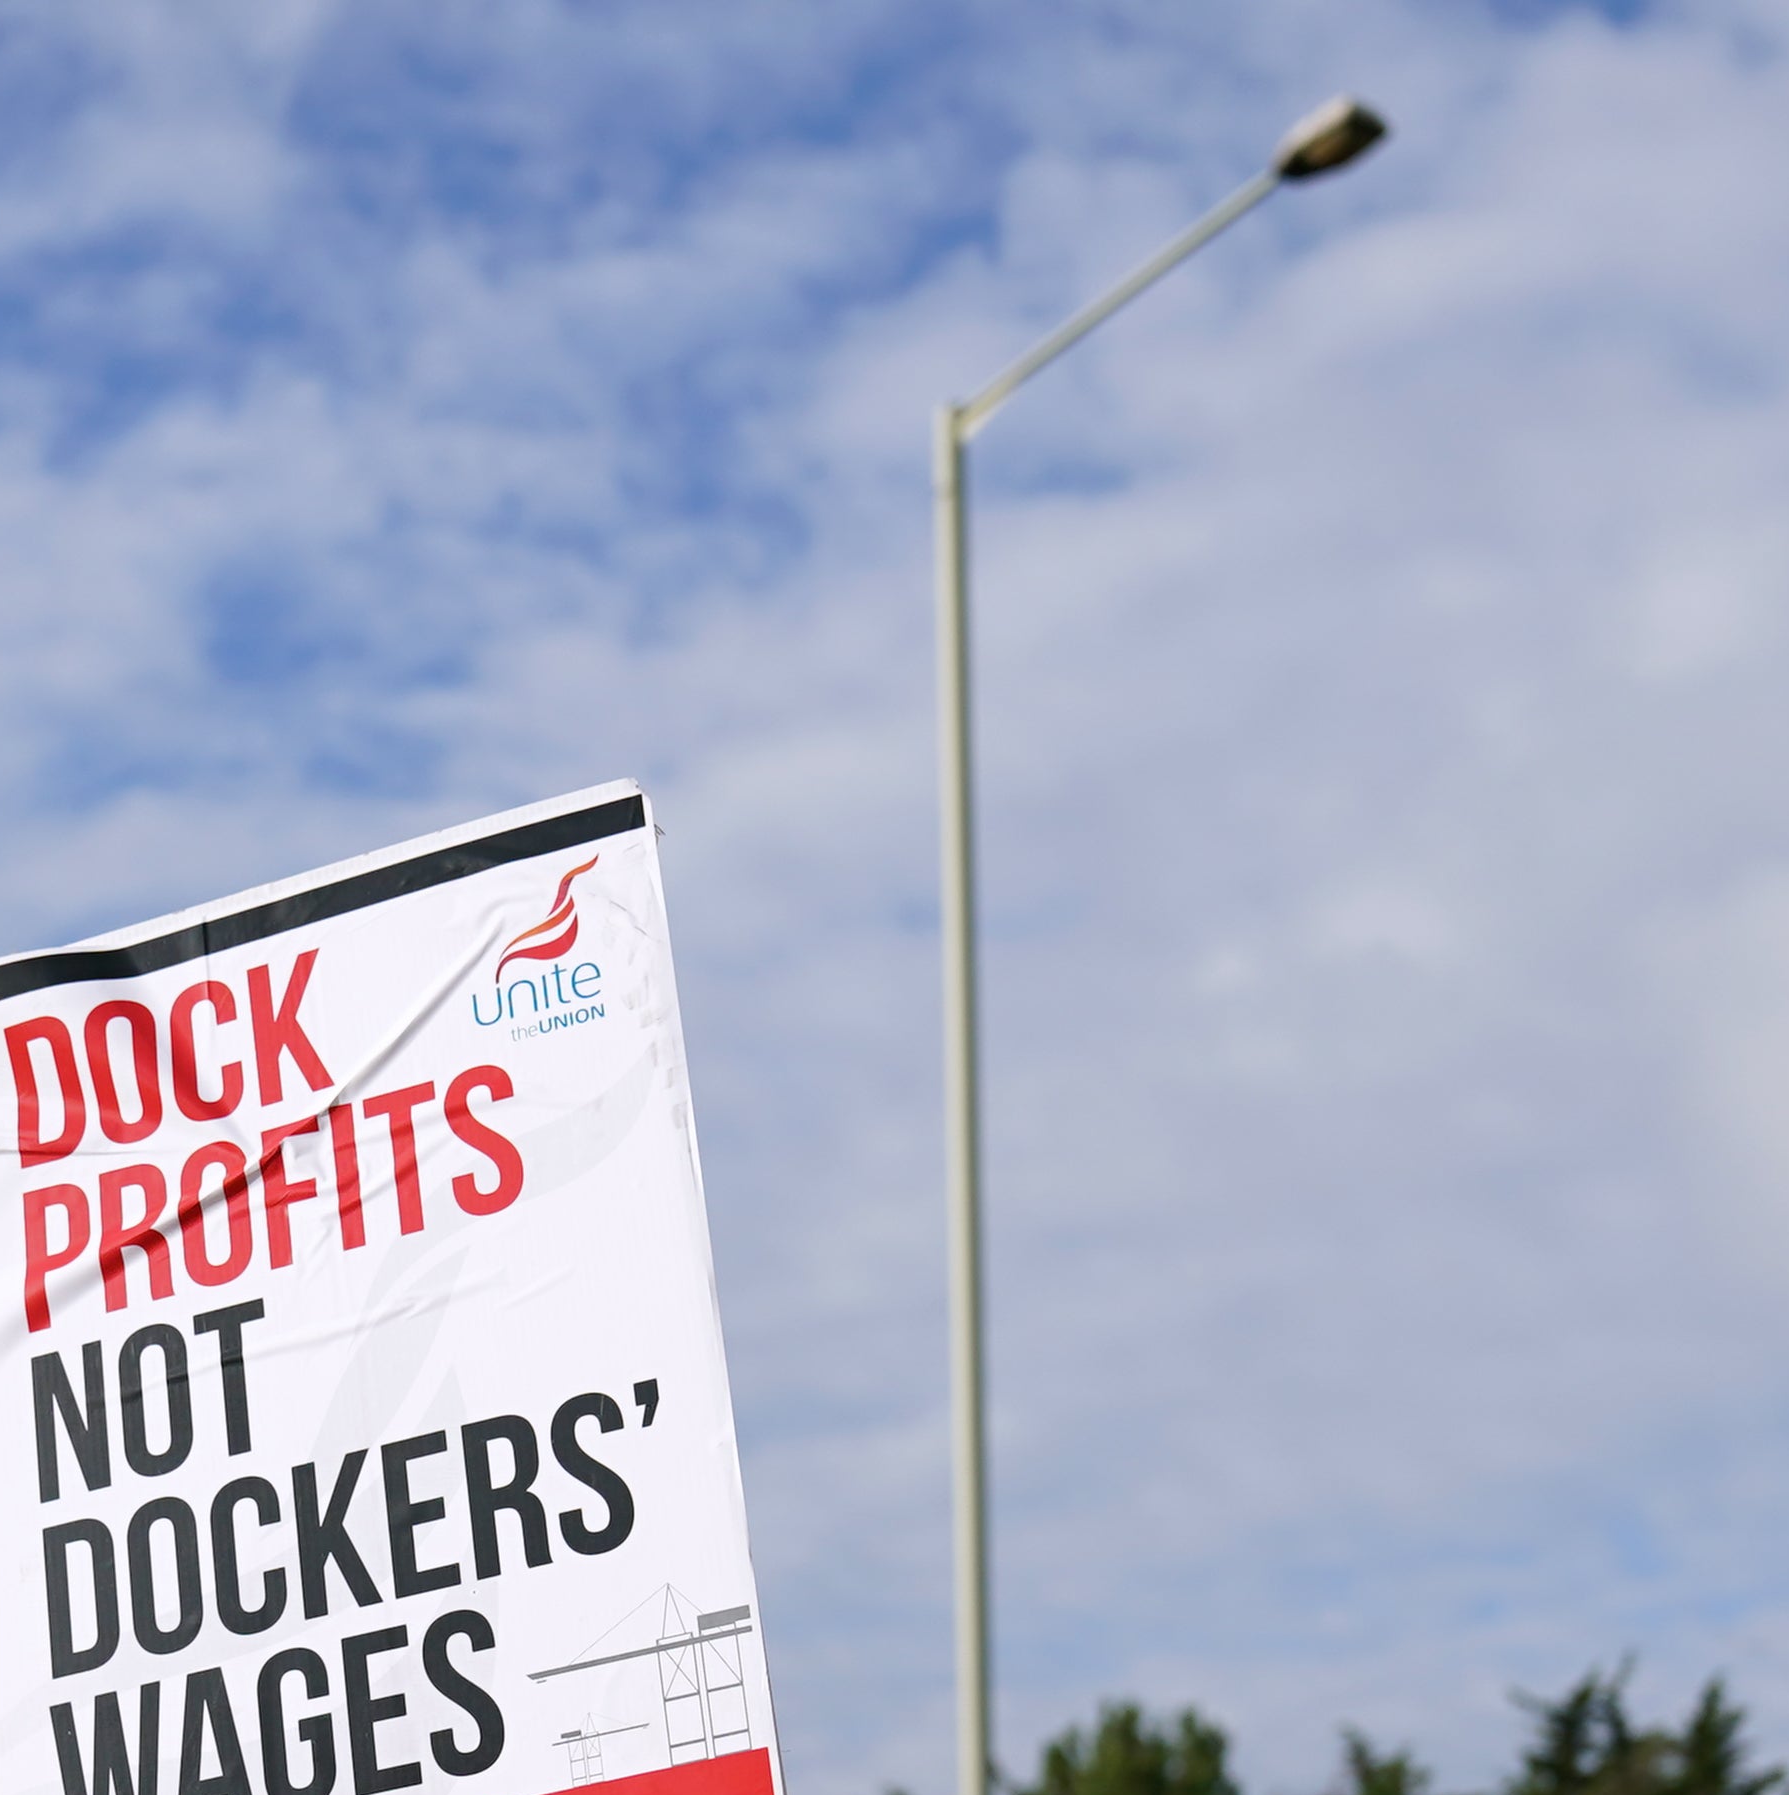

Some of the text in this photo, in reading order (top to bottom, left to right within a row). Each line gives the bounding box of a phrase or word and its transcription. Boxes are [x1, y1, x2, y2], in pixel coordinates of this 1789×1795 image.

[4, 948, 334, 1168] DOCK
[471, 962, 602, 1027] unite
[23, 1064, 525, 1333] PROFITS
[31, 1298, 266, 1503] NOT
[42, 1378, 660, 1679] DOCKERS’
